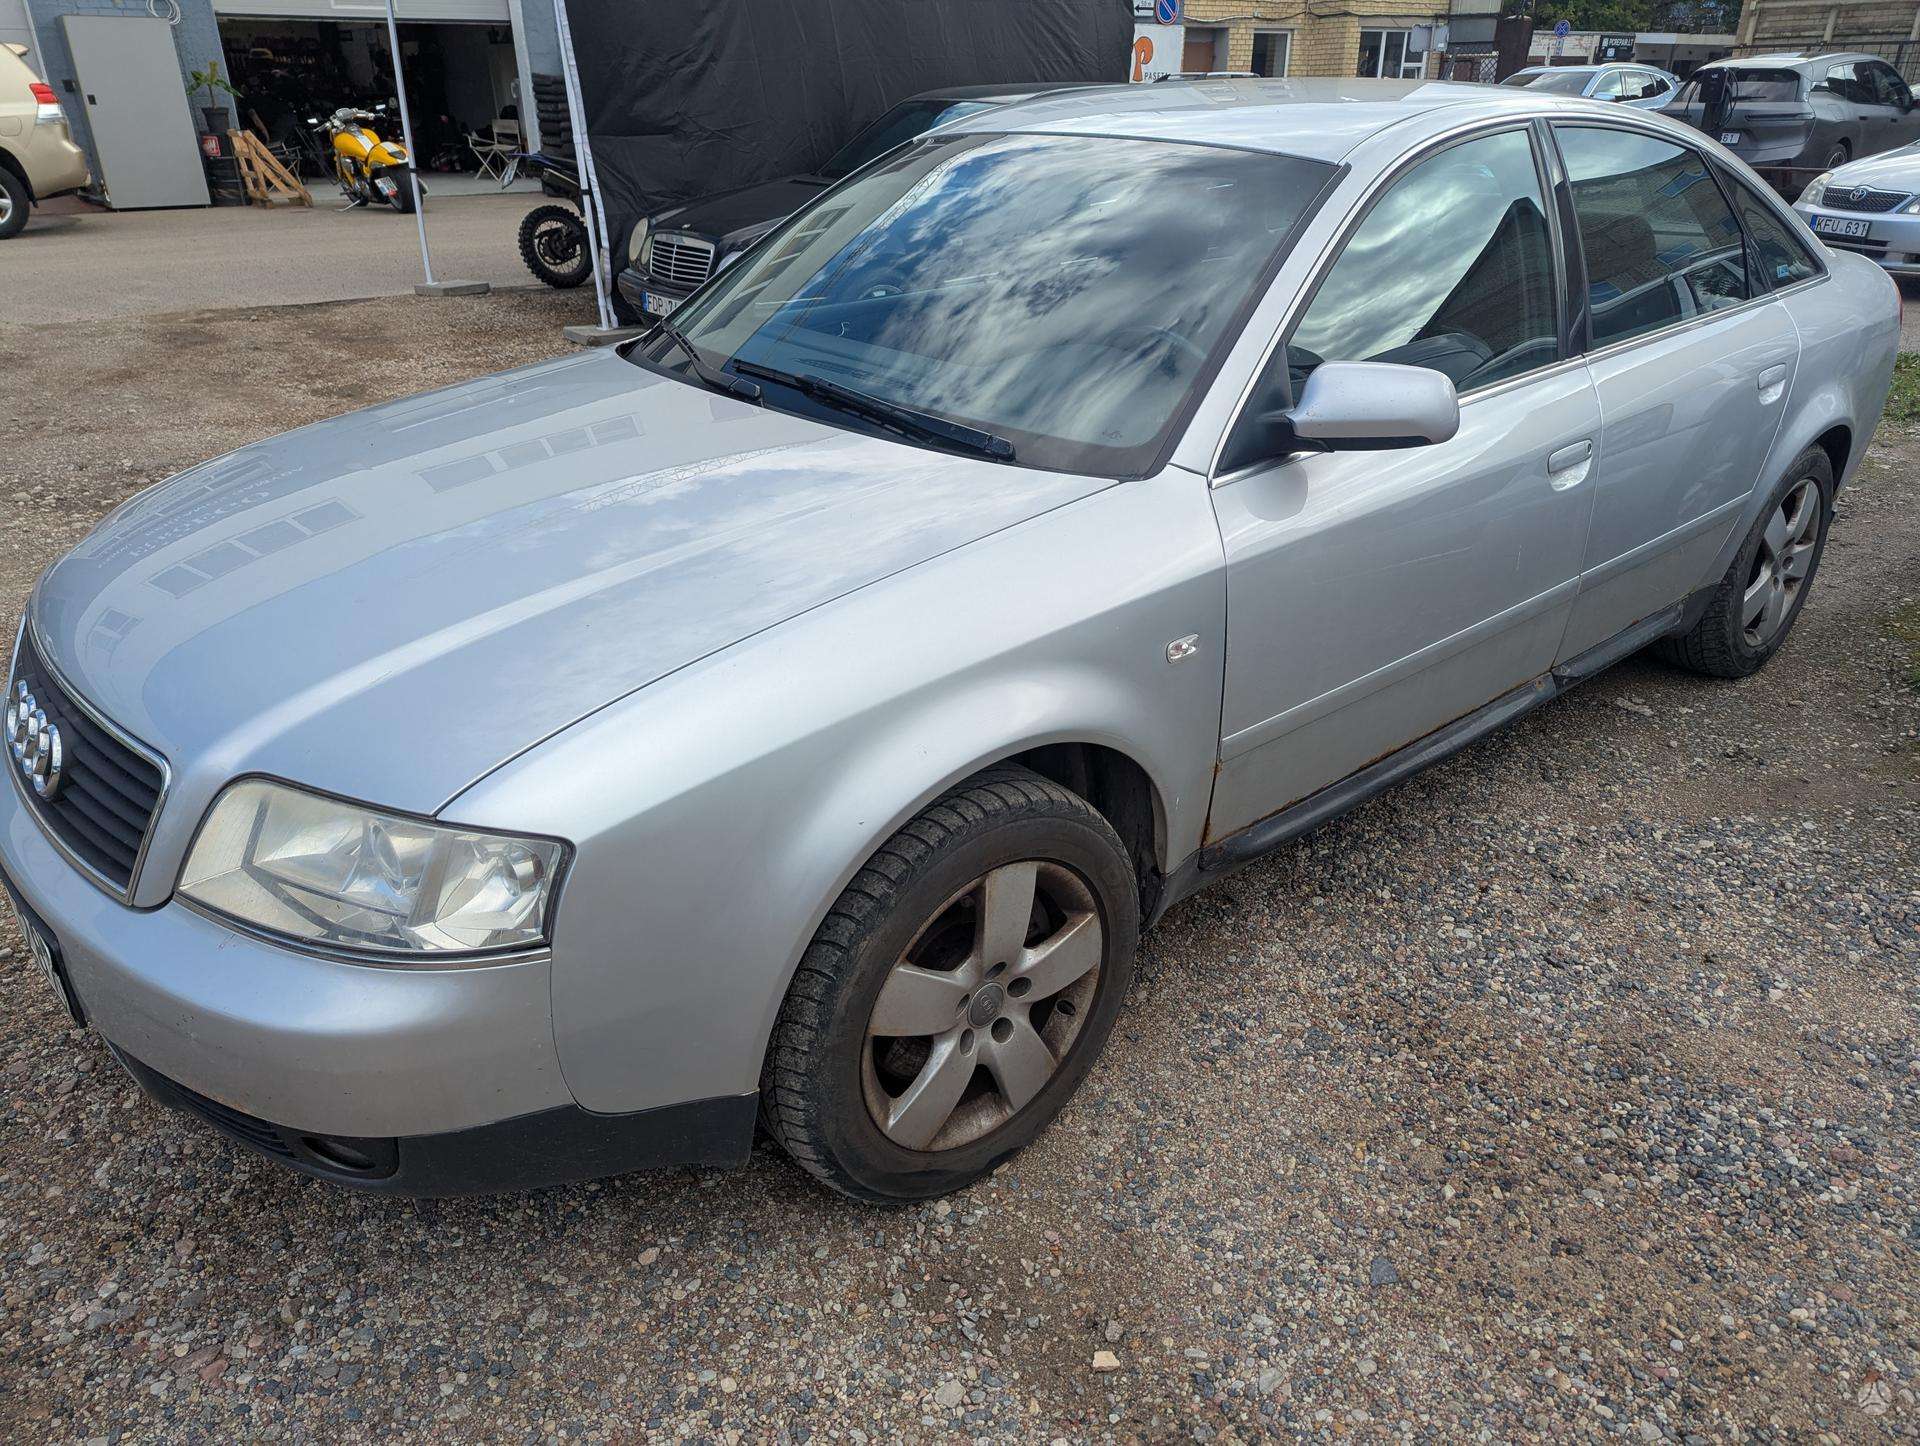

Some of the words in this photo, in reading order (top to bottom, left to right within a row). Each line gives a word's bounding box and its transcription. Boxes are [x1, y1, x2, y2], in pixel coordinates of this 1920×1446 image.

[1816, 218, 1840, 231] KFU
[1845, 222, 1867, 235] 631
[648, 294, 663, 314] FDP
